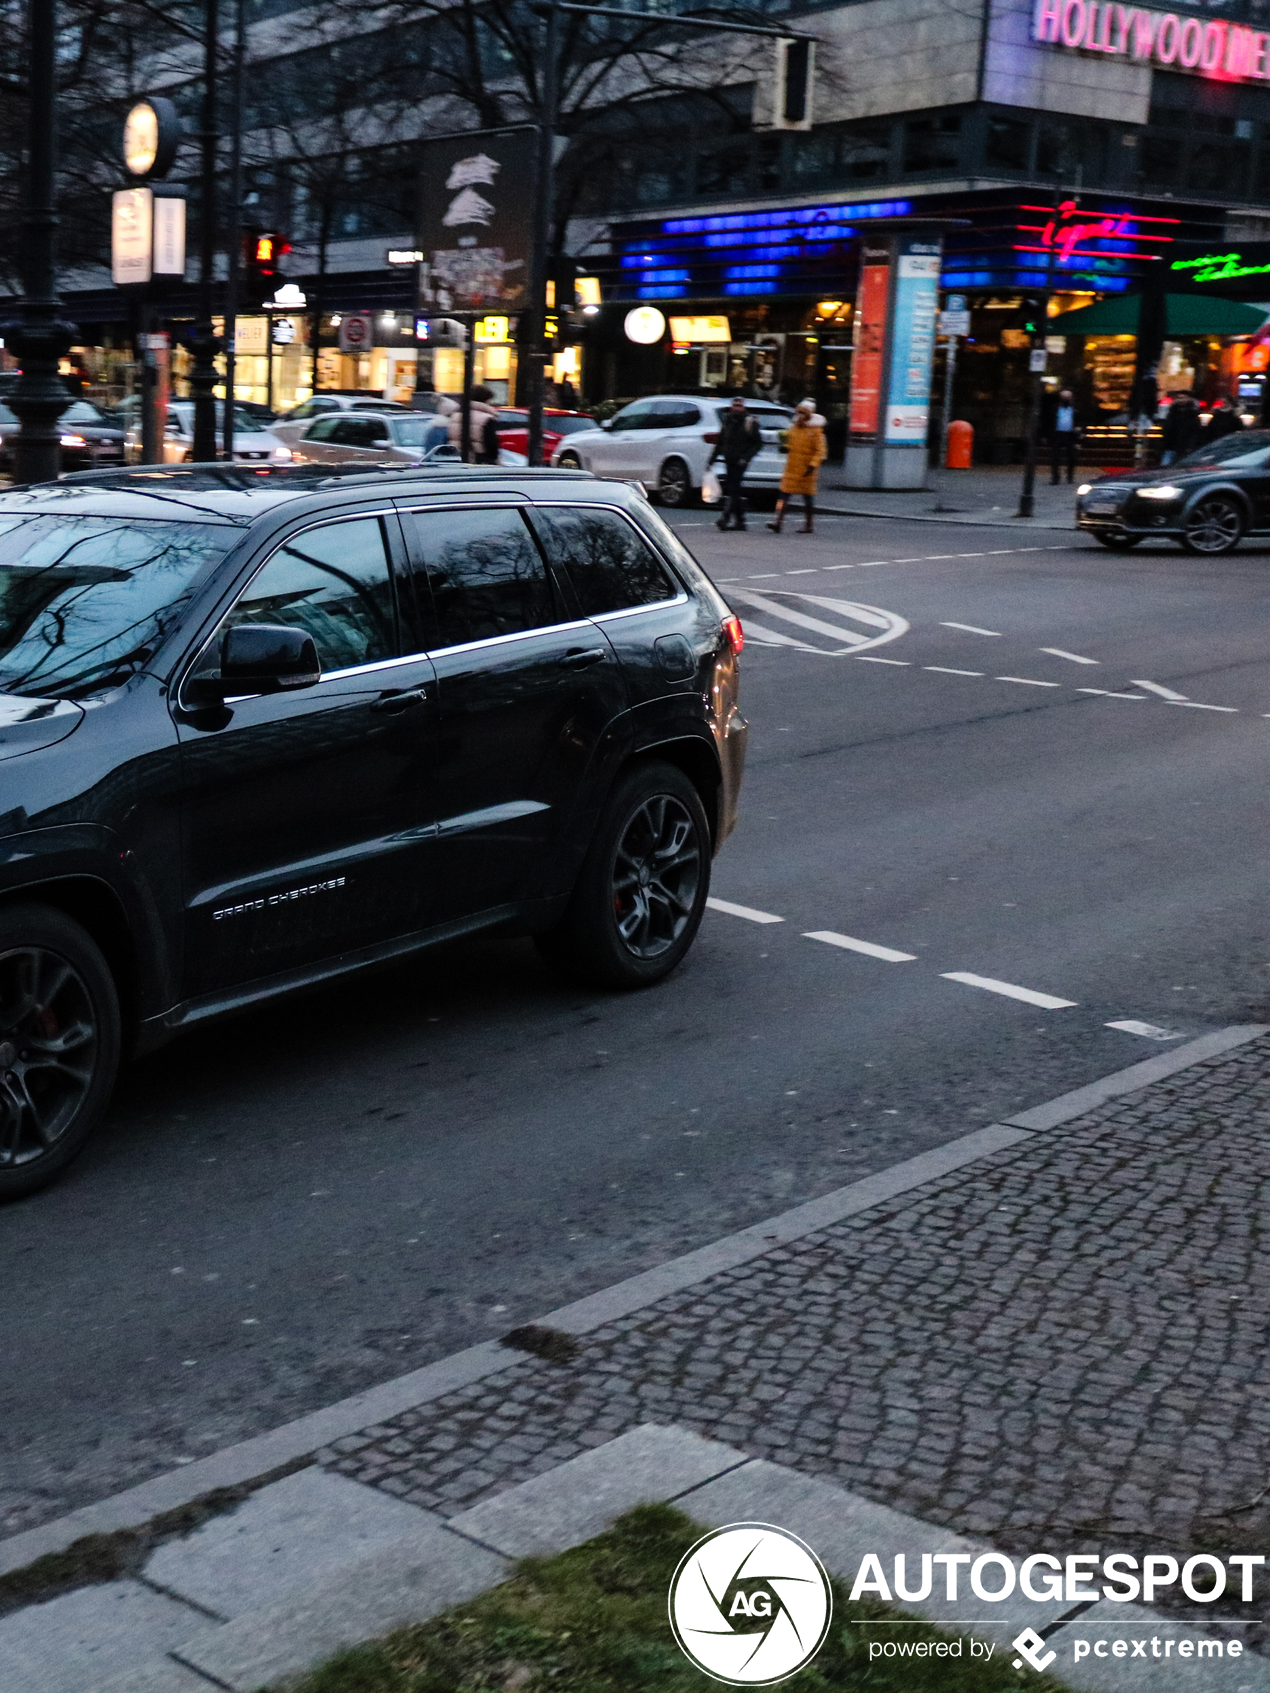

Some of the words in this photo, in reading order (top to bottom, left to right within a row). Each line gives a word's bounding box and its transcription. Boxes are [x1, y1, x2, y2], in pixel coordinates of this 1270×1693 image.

[1035, 0, 1226, 70] HOLLYWOOD
[212, 899, 265, 920] GRAND
[268, 877, 346, 905] CHEROKEE
